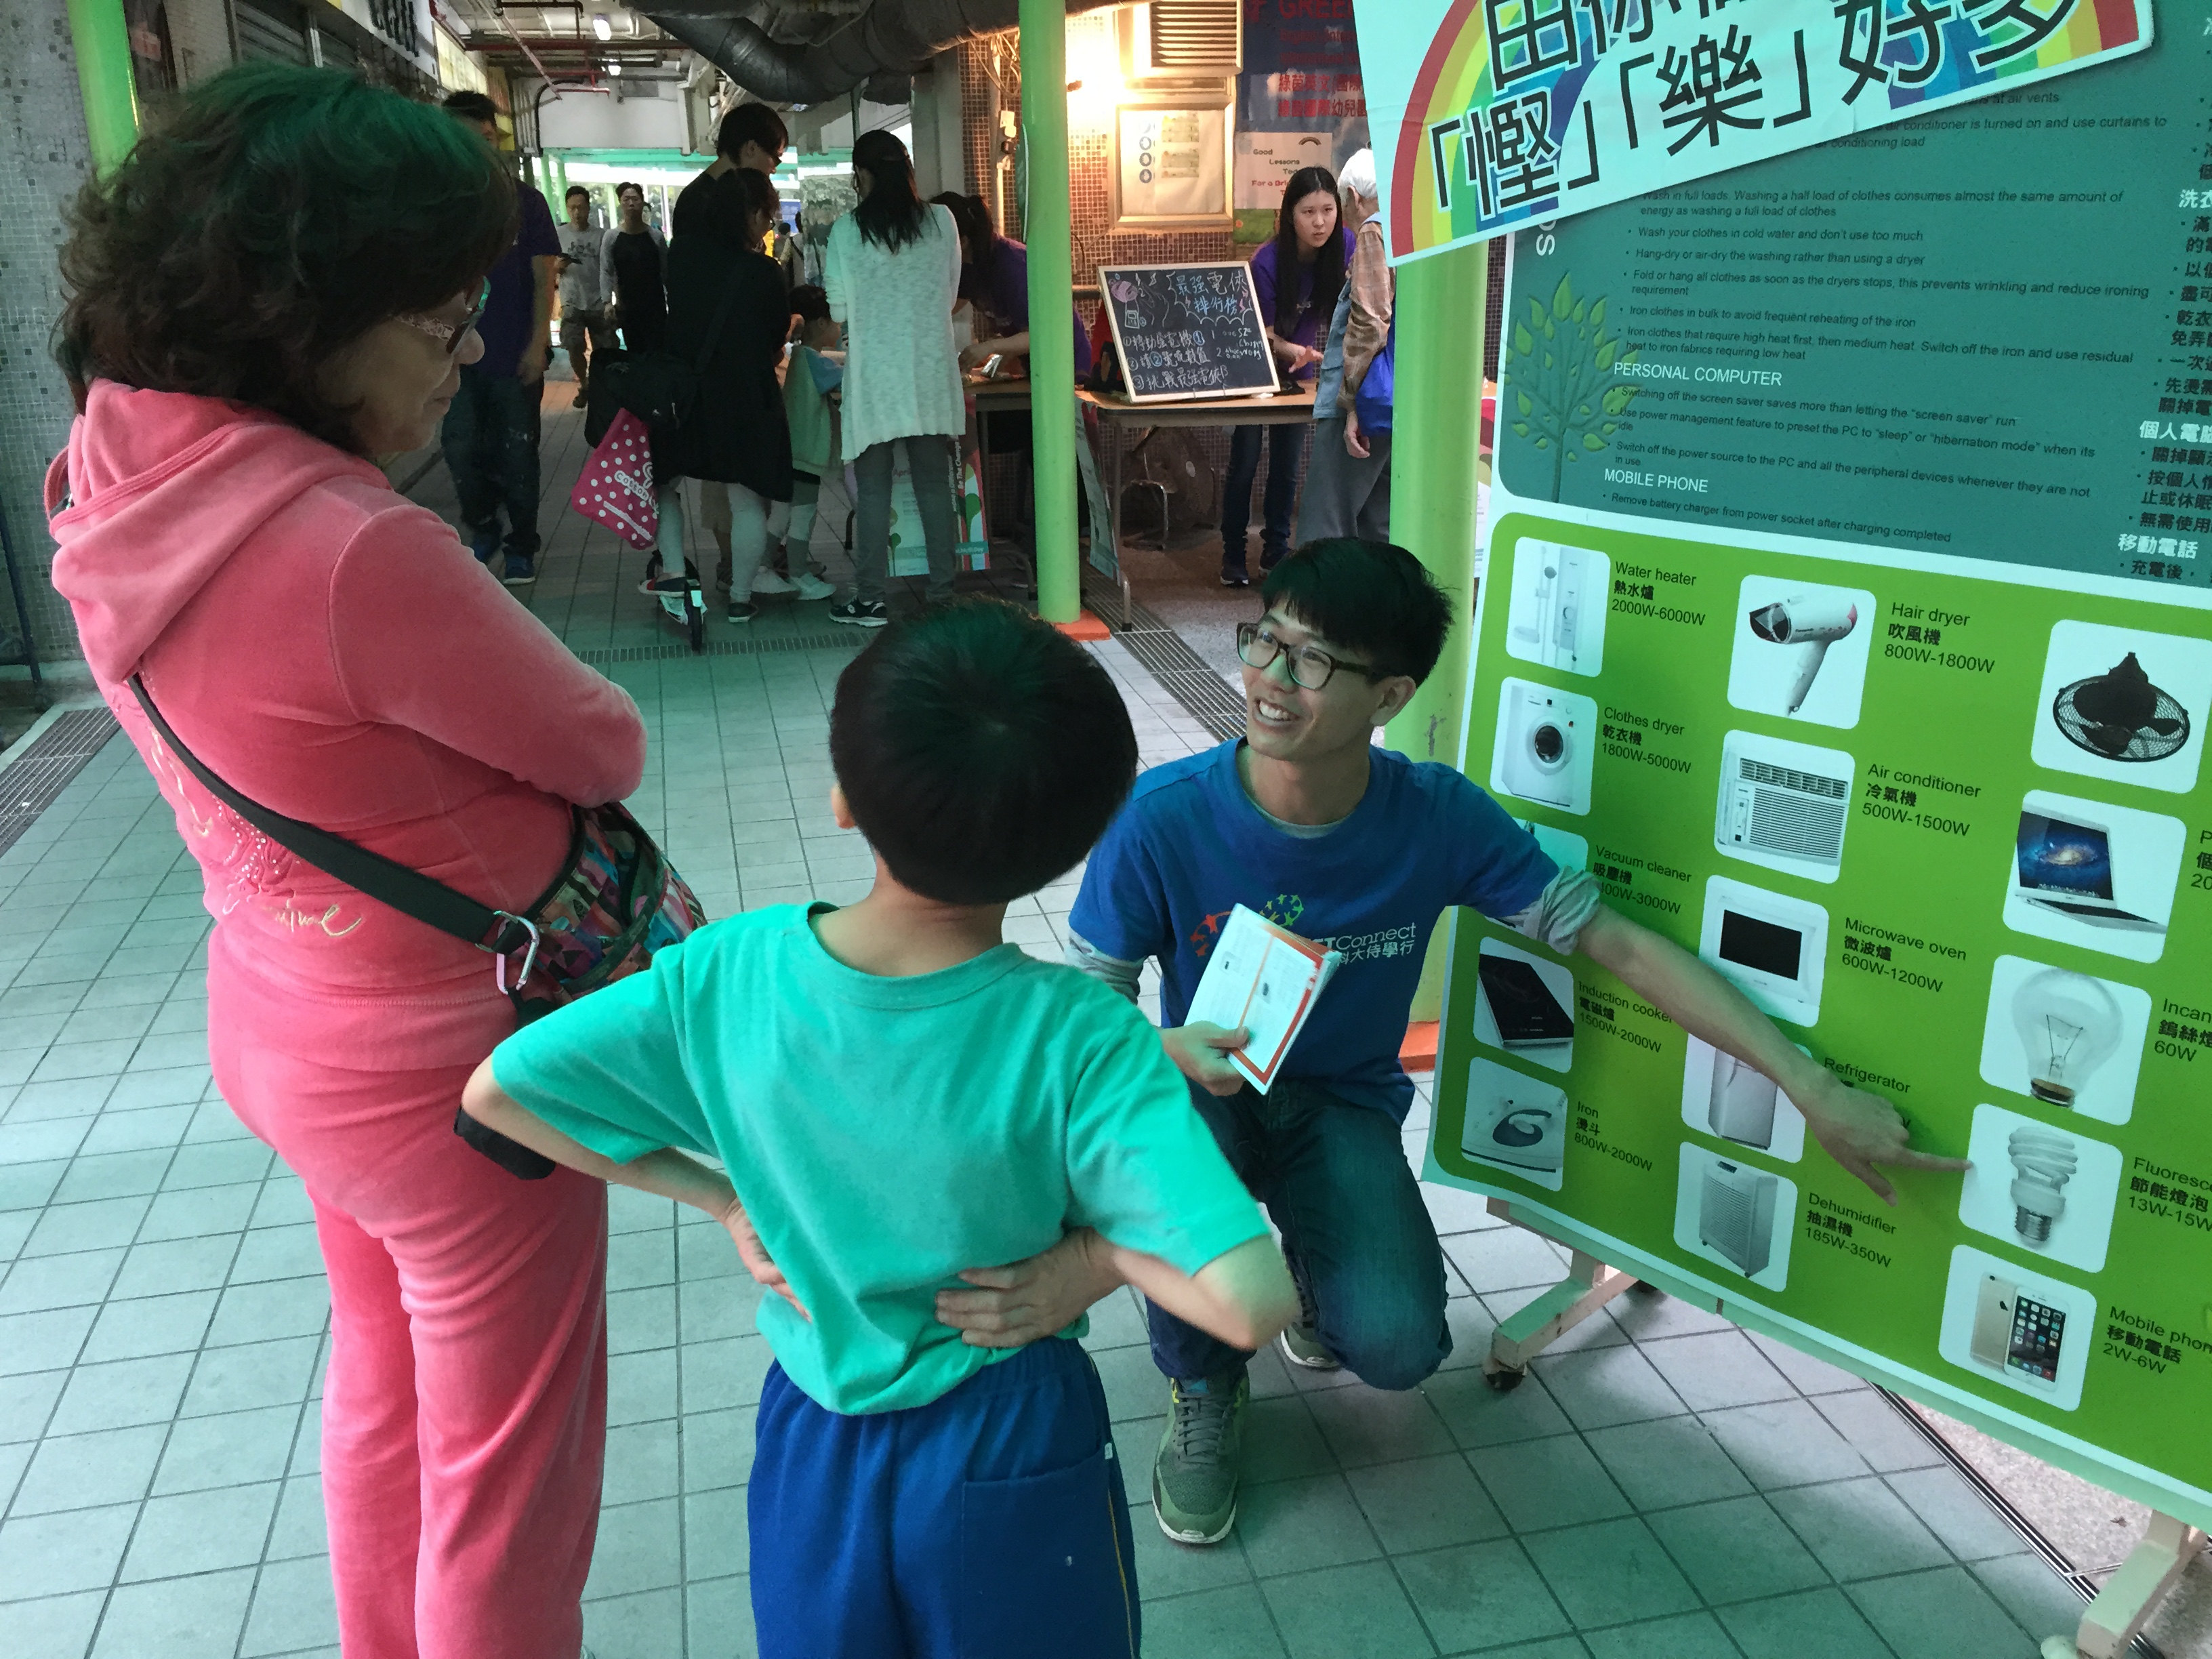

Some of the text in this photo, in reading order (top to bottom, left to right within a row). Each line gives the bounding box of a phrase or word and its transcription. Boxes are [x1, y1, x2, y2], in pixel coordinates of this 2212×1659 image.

[1639, 227, 1665, 237] Wash
[1668, 230, 1689, 239] your
[1692, 228, 1727, 237] clothes
[1731, 228, 1740, 237] in
[1743, 228, 1764, 238] cold
[1767, 230, 1795, 239] water
[1798, 230, 1818, 239] and
[1872, 231, 1889, 240] too
[1893, 231, 1923, 241] much
[1630, 306, 1647, 315] Iron
[1650, 307, 1684, 316] clothes
[1698, 308, 1719, 318] bulk
[1722, 310, 1732, 319] to
[1734, 311, 1761, 320] avoid
[1765, 312, 1807, 323] frequent
[1809, 314, 1858, 327] reheating
[1862, 315, 1873, 325] of
[1875, 316, 1892, 326] the
[1614, 363, 1782, 386] PERSONAL COMPUTER
[1618, 422, 1634, 431] idle
[1618, 406, 1637, 417] Use
[1639, 411, 1667, 419] power
[1670, 414, 1734, 425] management
[1736, 417, 1771, 428] feature
[1775, 421, 1784, 430] to
[1787, 424, 1820, 432] preset
[1822, 424, 1839, 434] the
[1842, 426, 1858, 436] PC
[1862, 428, 1872, 437] to
[2044, 445, 2076, 455] when
[2081, 447, 2095, 457] its
[1605, 469, 1708, 493] MOBILE PHONE
[1617, 441, 2090, 497] Switch off the power source to the PC and all the peripheral devices whenever they are not
[1612, 493, 1951, 541] Remove battery charger from power socket after charging completed
[2118, 533, 2198, 559] 移動電話
[1616, 562, 1697, 586] Water heater
[1612, 598, 1706, 626] 2000W-6000W
[1891, 602, 1971, 629] Hair dryer
[1884, 644, 1995, 674] 800W-1800W
[1604, 707, 1685, 736] Clothes dryer
[1602, 743, 1692, 775] 1800W-5000W
[1868, 763, 1982, 798] Air conditioner
[1862, 802, 1971, 836] 500W-1500W
[1596, 845, 1692, 882] Vacuum cleaner
[1845, 917, 1967, 960] Microwave oven
[1842, 953, 1944, 993] 600W-1200W
[1579, 981, 1629, 1008] Induction
[1580, 1012, 1661, 1053] 1500W-2000W
[2154, 1040, 2196, 1062] 60W
[1824, 1057, 1910, 1094] Refrigerator
[1576, 1101, 1599, 1119] Iron
[1574, 1132, 1653, 1172] 800W-2000W
[1808, 1192, 1897, 1235] Dehumidifier
[2129, 1196, 2212, 1231] 13W-15W
[1804, 1227, 1891, 1268] 185W-350W
[2110, 1306, 2165, 1336] Mobile
[2103, 1343, 2167, 1374] 2W-6W
